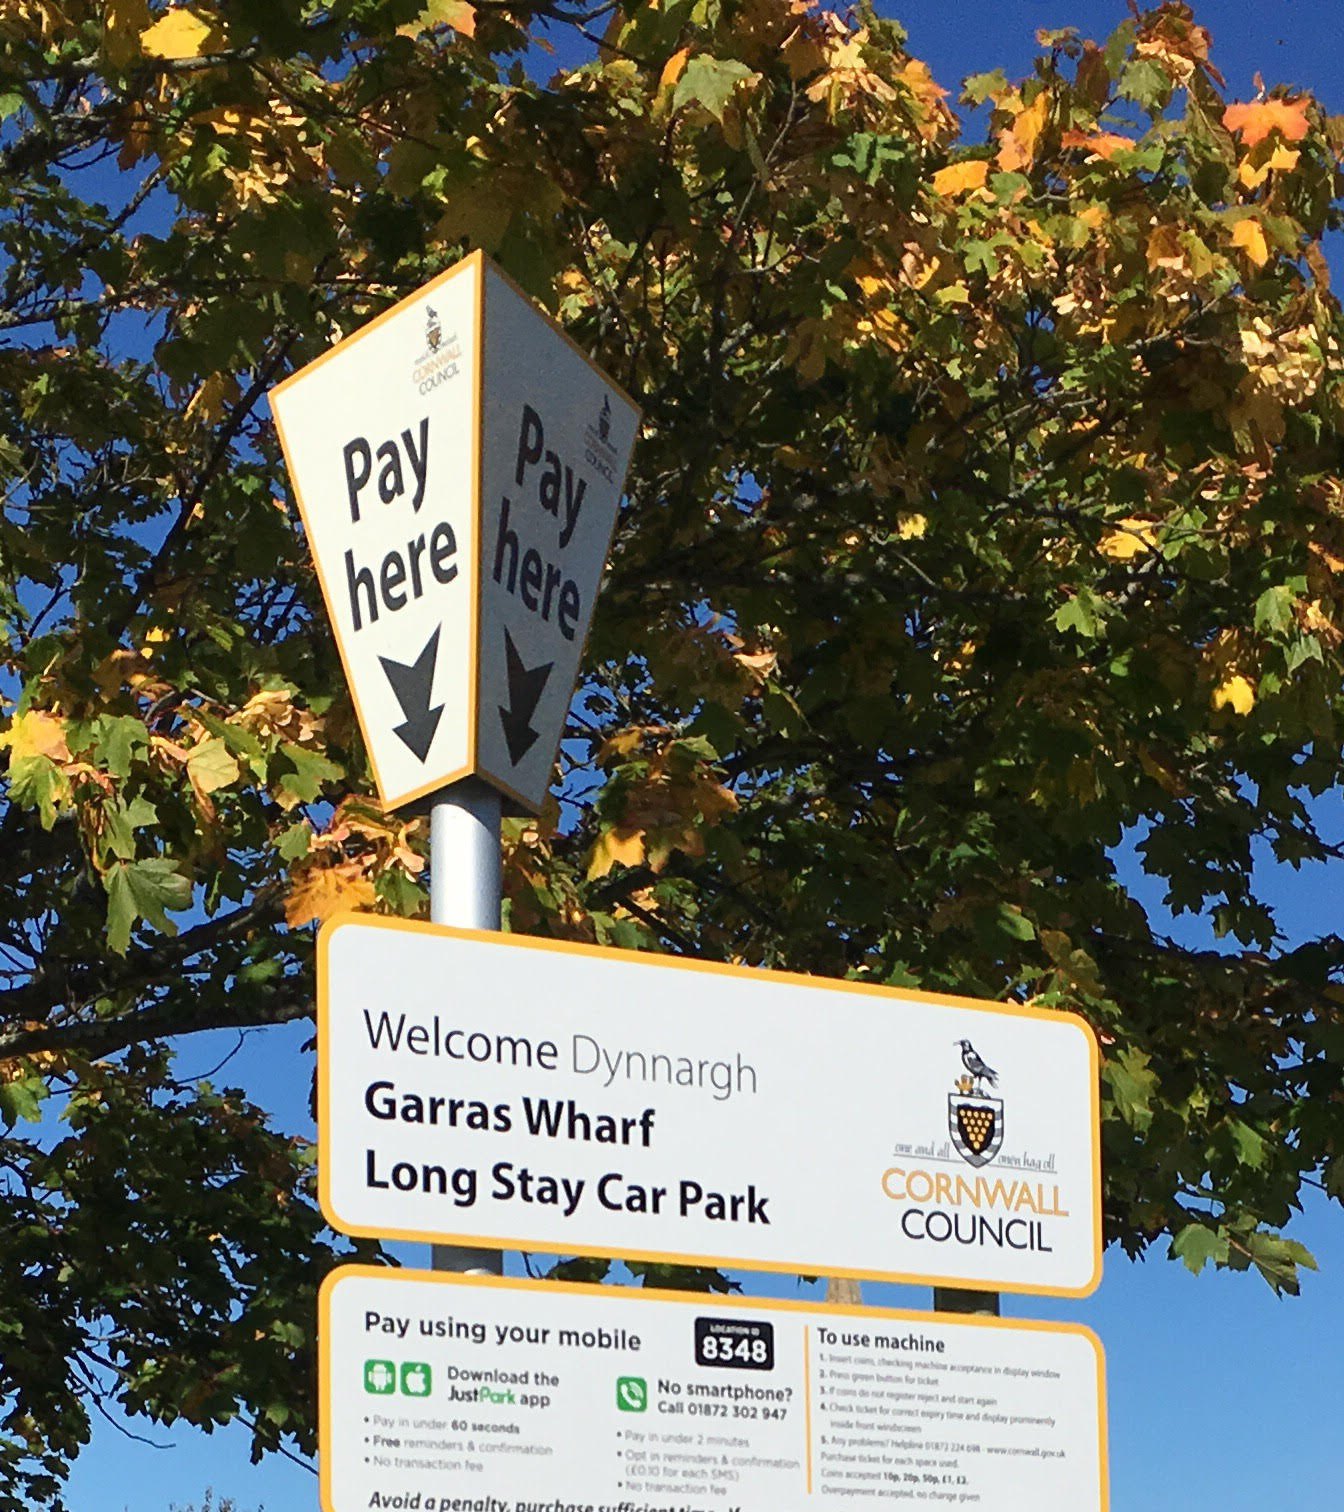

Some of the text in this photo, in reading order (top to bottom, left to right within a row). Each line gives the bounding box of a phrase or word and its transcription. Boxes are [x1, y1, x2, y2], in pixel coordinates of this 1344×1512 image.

[418, 362, 460, 396] COUNCIL
[342, 416, 430, 523] Pay
[515, 404, 589, 549] Pay
[345, 520, 459, 632] here
[493, 497, 582, 642] here
[363, 1008, 757, 1098] Welcome Dynnargh
[364, 1080, 656, 1148] Garras Wharf
[366, 1148, 771, 1225] Long Stay Car Park
[881, 1167, 1070, 1217] CORNWALL
[901, 1208, 1053, 1253] COUNCIL
[365, 1310, 642, 1351] Pay using your mobile
[702, 1336, 768, 1363] 8348
[817, 1327, 945, 1353] To use machine
[447, 1365, 560, 1387] Download the
[657, 1379, 793, 1402] No smartphone?
[447, 1386, 551, 1409] JustPark app
[657, 1401, 787, 1421] Call 01872 302 947
[372, 1435, 401, 1449] Free
[368, 1491, 422, 1510] Avoid
[424, 1497, 436, 1511] a
